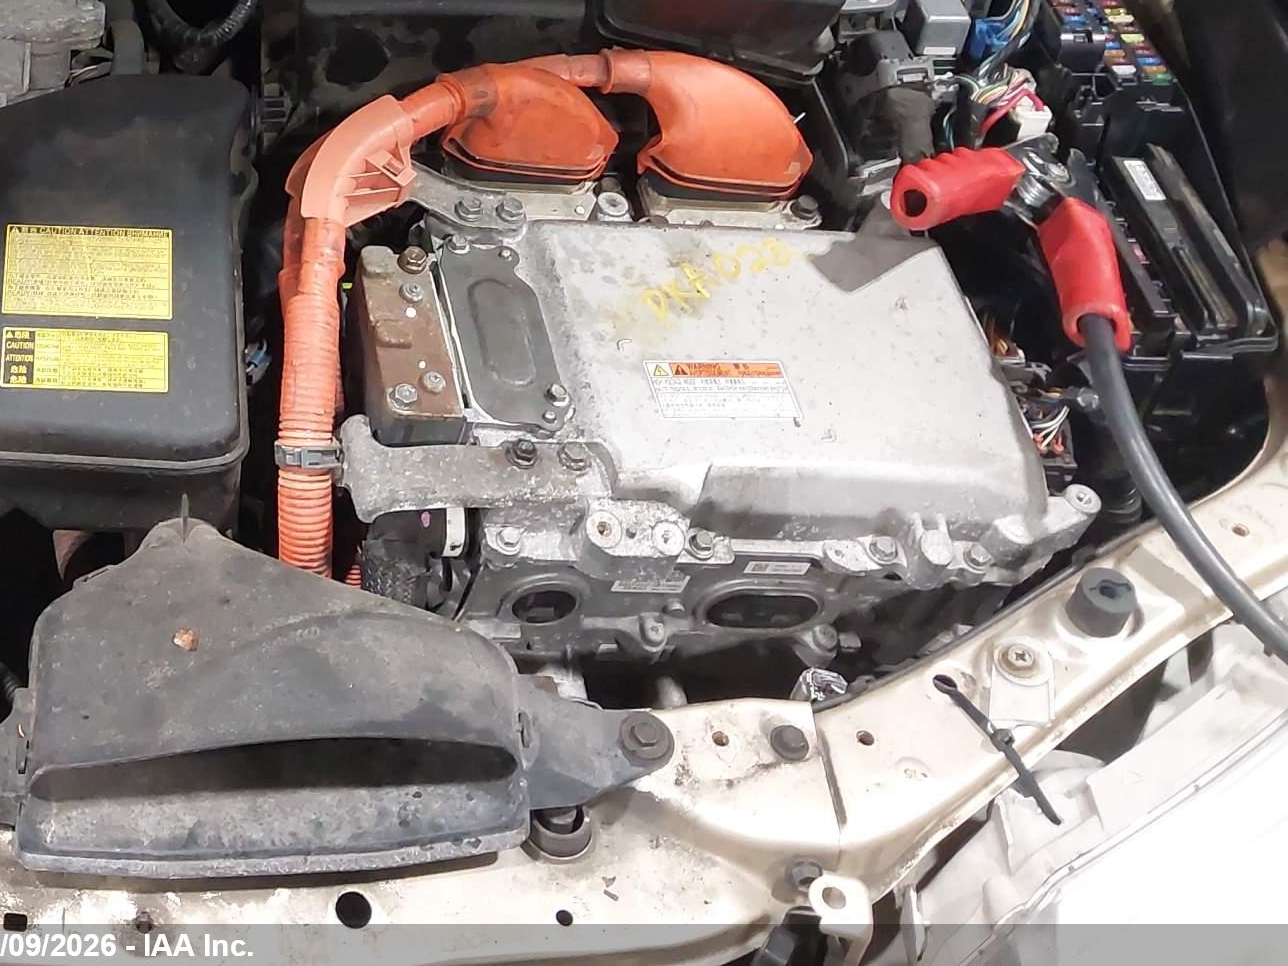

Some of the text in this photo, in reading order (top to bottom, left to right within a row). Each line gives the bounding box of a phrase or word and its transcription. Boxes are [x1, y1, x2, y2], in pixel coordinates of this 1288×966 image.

[39, 226, 77, 235] CAUTION
[79, 228, 125, 237] ATTENTION
[6, 341, 34, 350] CAUTION
[5, 354, 34, 363] ATTENTION
